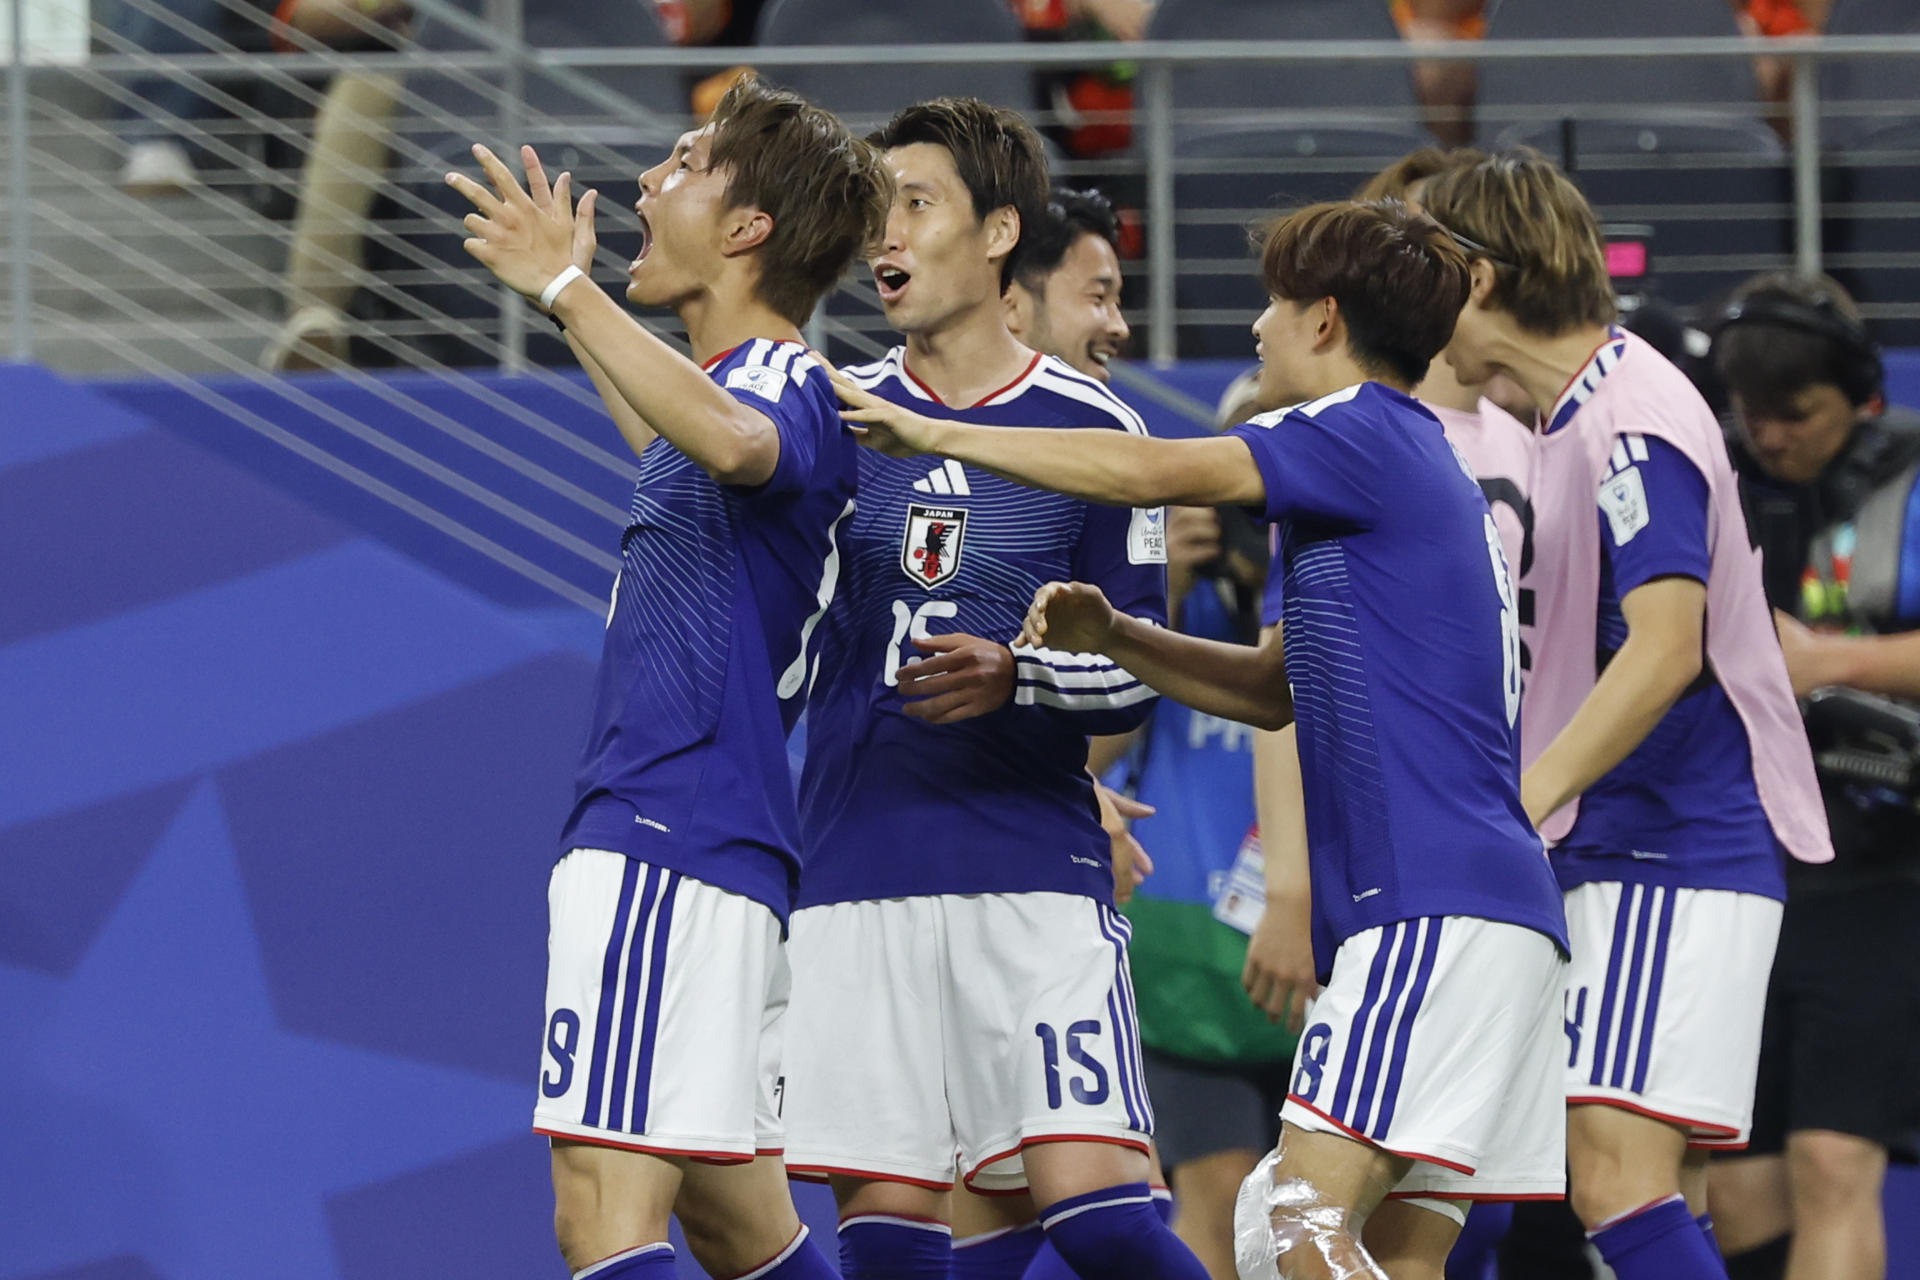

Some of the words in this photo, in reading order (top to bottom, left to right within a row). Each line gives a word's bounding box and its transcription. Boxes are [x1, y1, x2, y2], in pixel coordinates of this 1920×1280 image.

[923, 509, 955, 519] JAPAN
[1143, 537, 1163, 549] PEAC
[542, 1007, 580, 1099] 9
[1035, 1019, 1110, 1110] 15
[1292, 1022, 1332, 1104] 8
